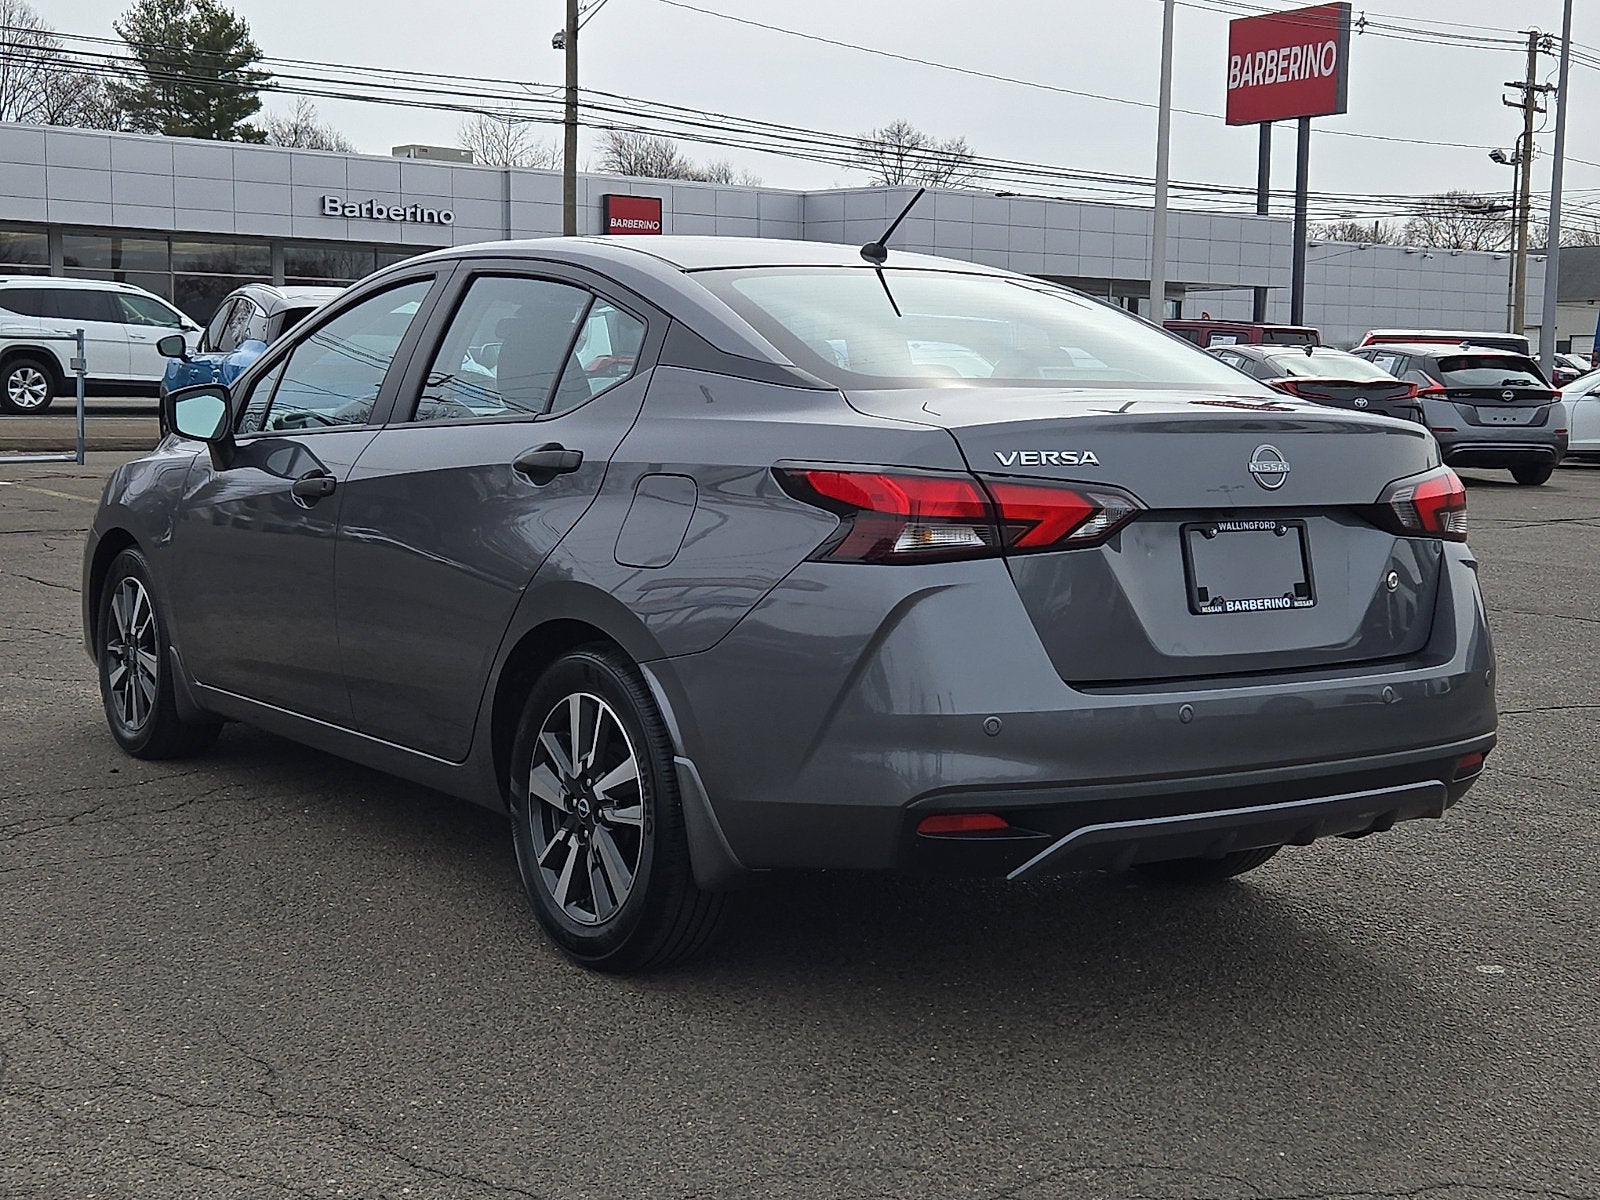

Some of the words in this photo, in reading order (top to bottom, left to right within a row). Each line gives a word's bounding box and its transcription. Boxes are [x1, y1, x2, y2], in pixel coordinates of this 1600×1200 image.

[1228, 40, 1337, 90] BARBERINO
[322, 195, 455, 225] Barberino
[610, 217, 660, 230] BARBERINO
[994, 450, 1100, 466] VERSA
[1250, 462, 1290, 472] NISSAN
[1218, 521, 1276, 531] WALLINGFORD
[1225, 598, 1291, 612] BARBERINO
